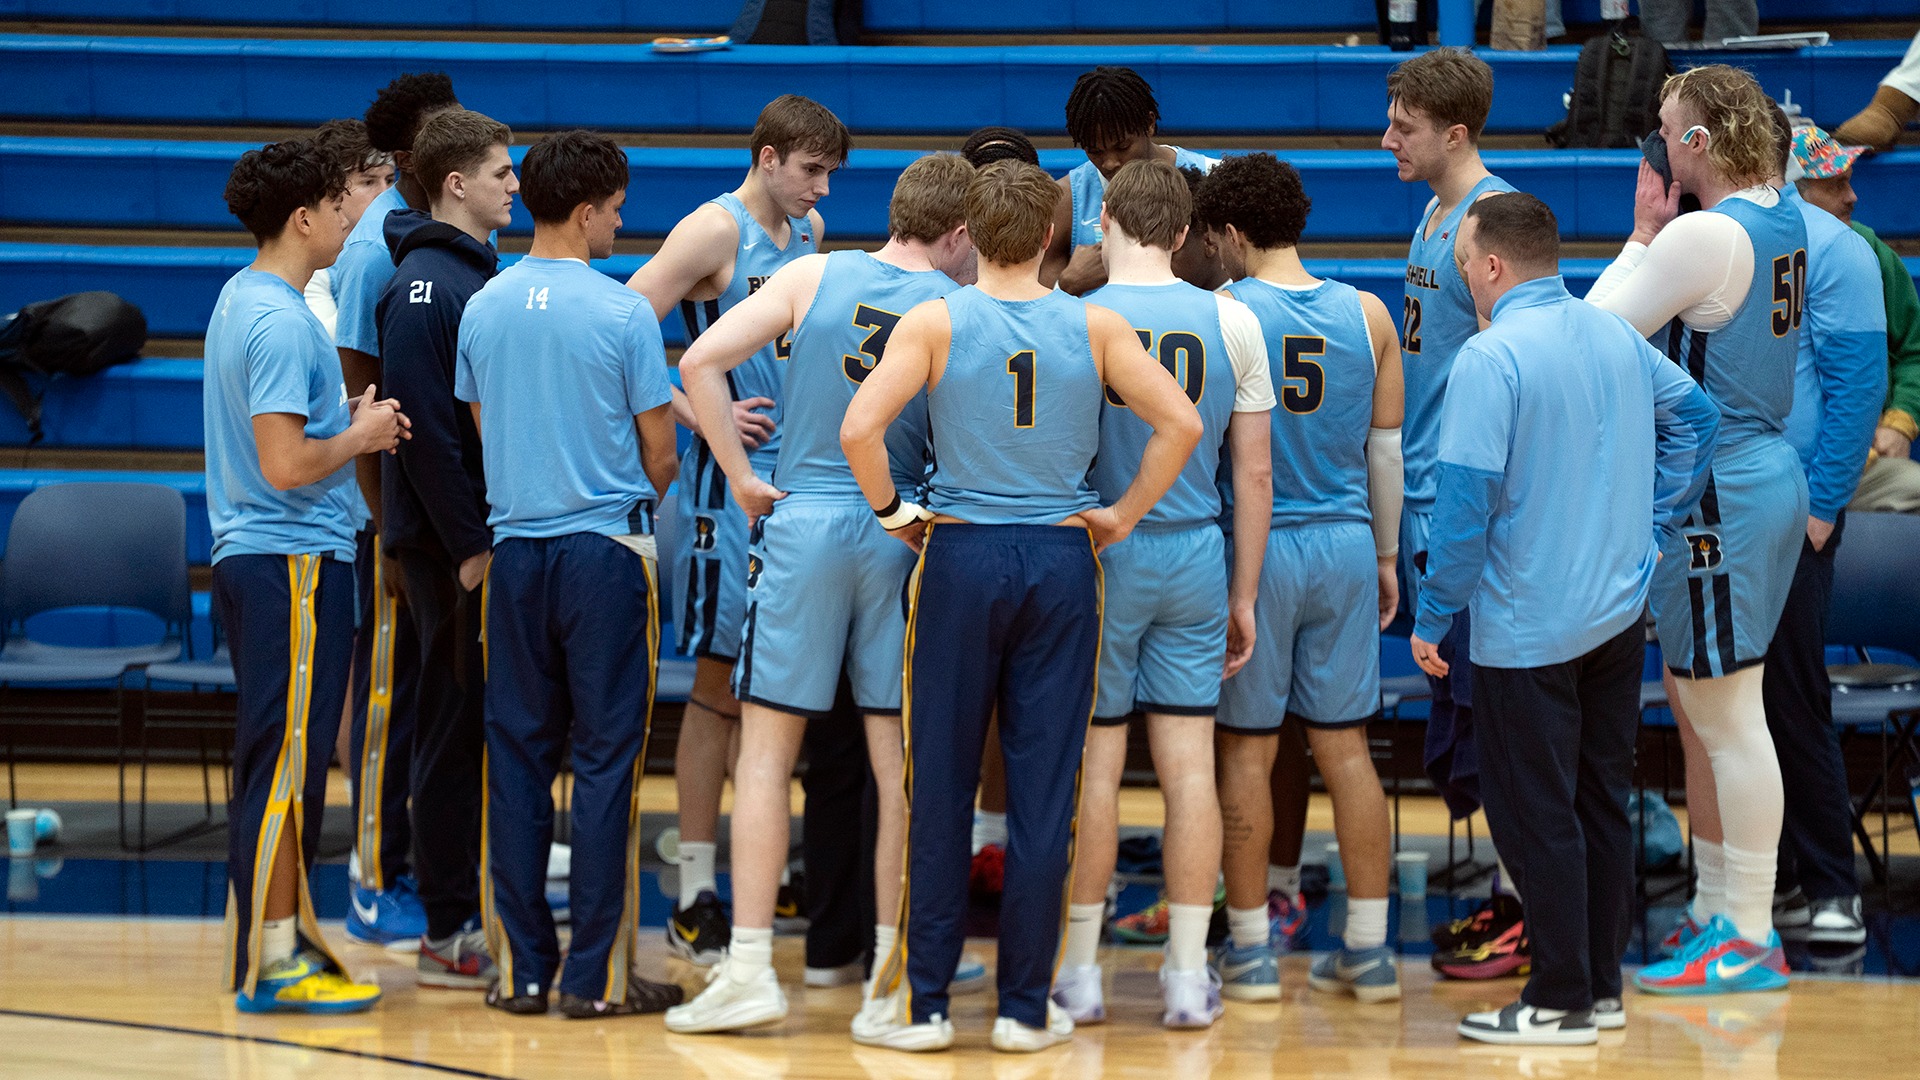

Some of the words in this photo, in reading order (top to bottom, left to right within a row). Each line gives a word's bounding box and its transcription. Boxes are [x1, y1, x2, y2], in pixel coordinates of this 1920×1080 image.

[409, 280, 433, 304] 21
[525, 286, 550, 310] 14
[1771, 247, 1807, 338] 50
[1006, 350, 1036, 428] 1
[1281, 334, 1326, 415] 5
[1683, 531, 1724, 571] B
